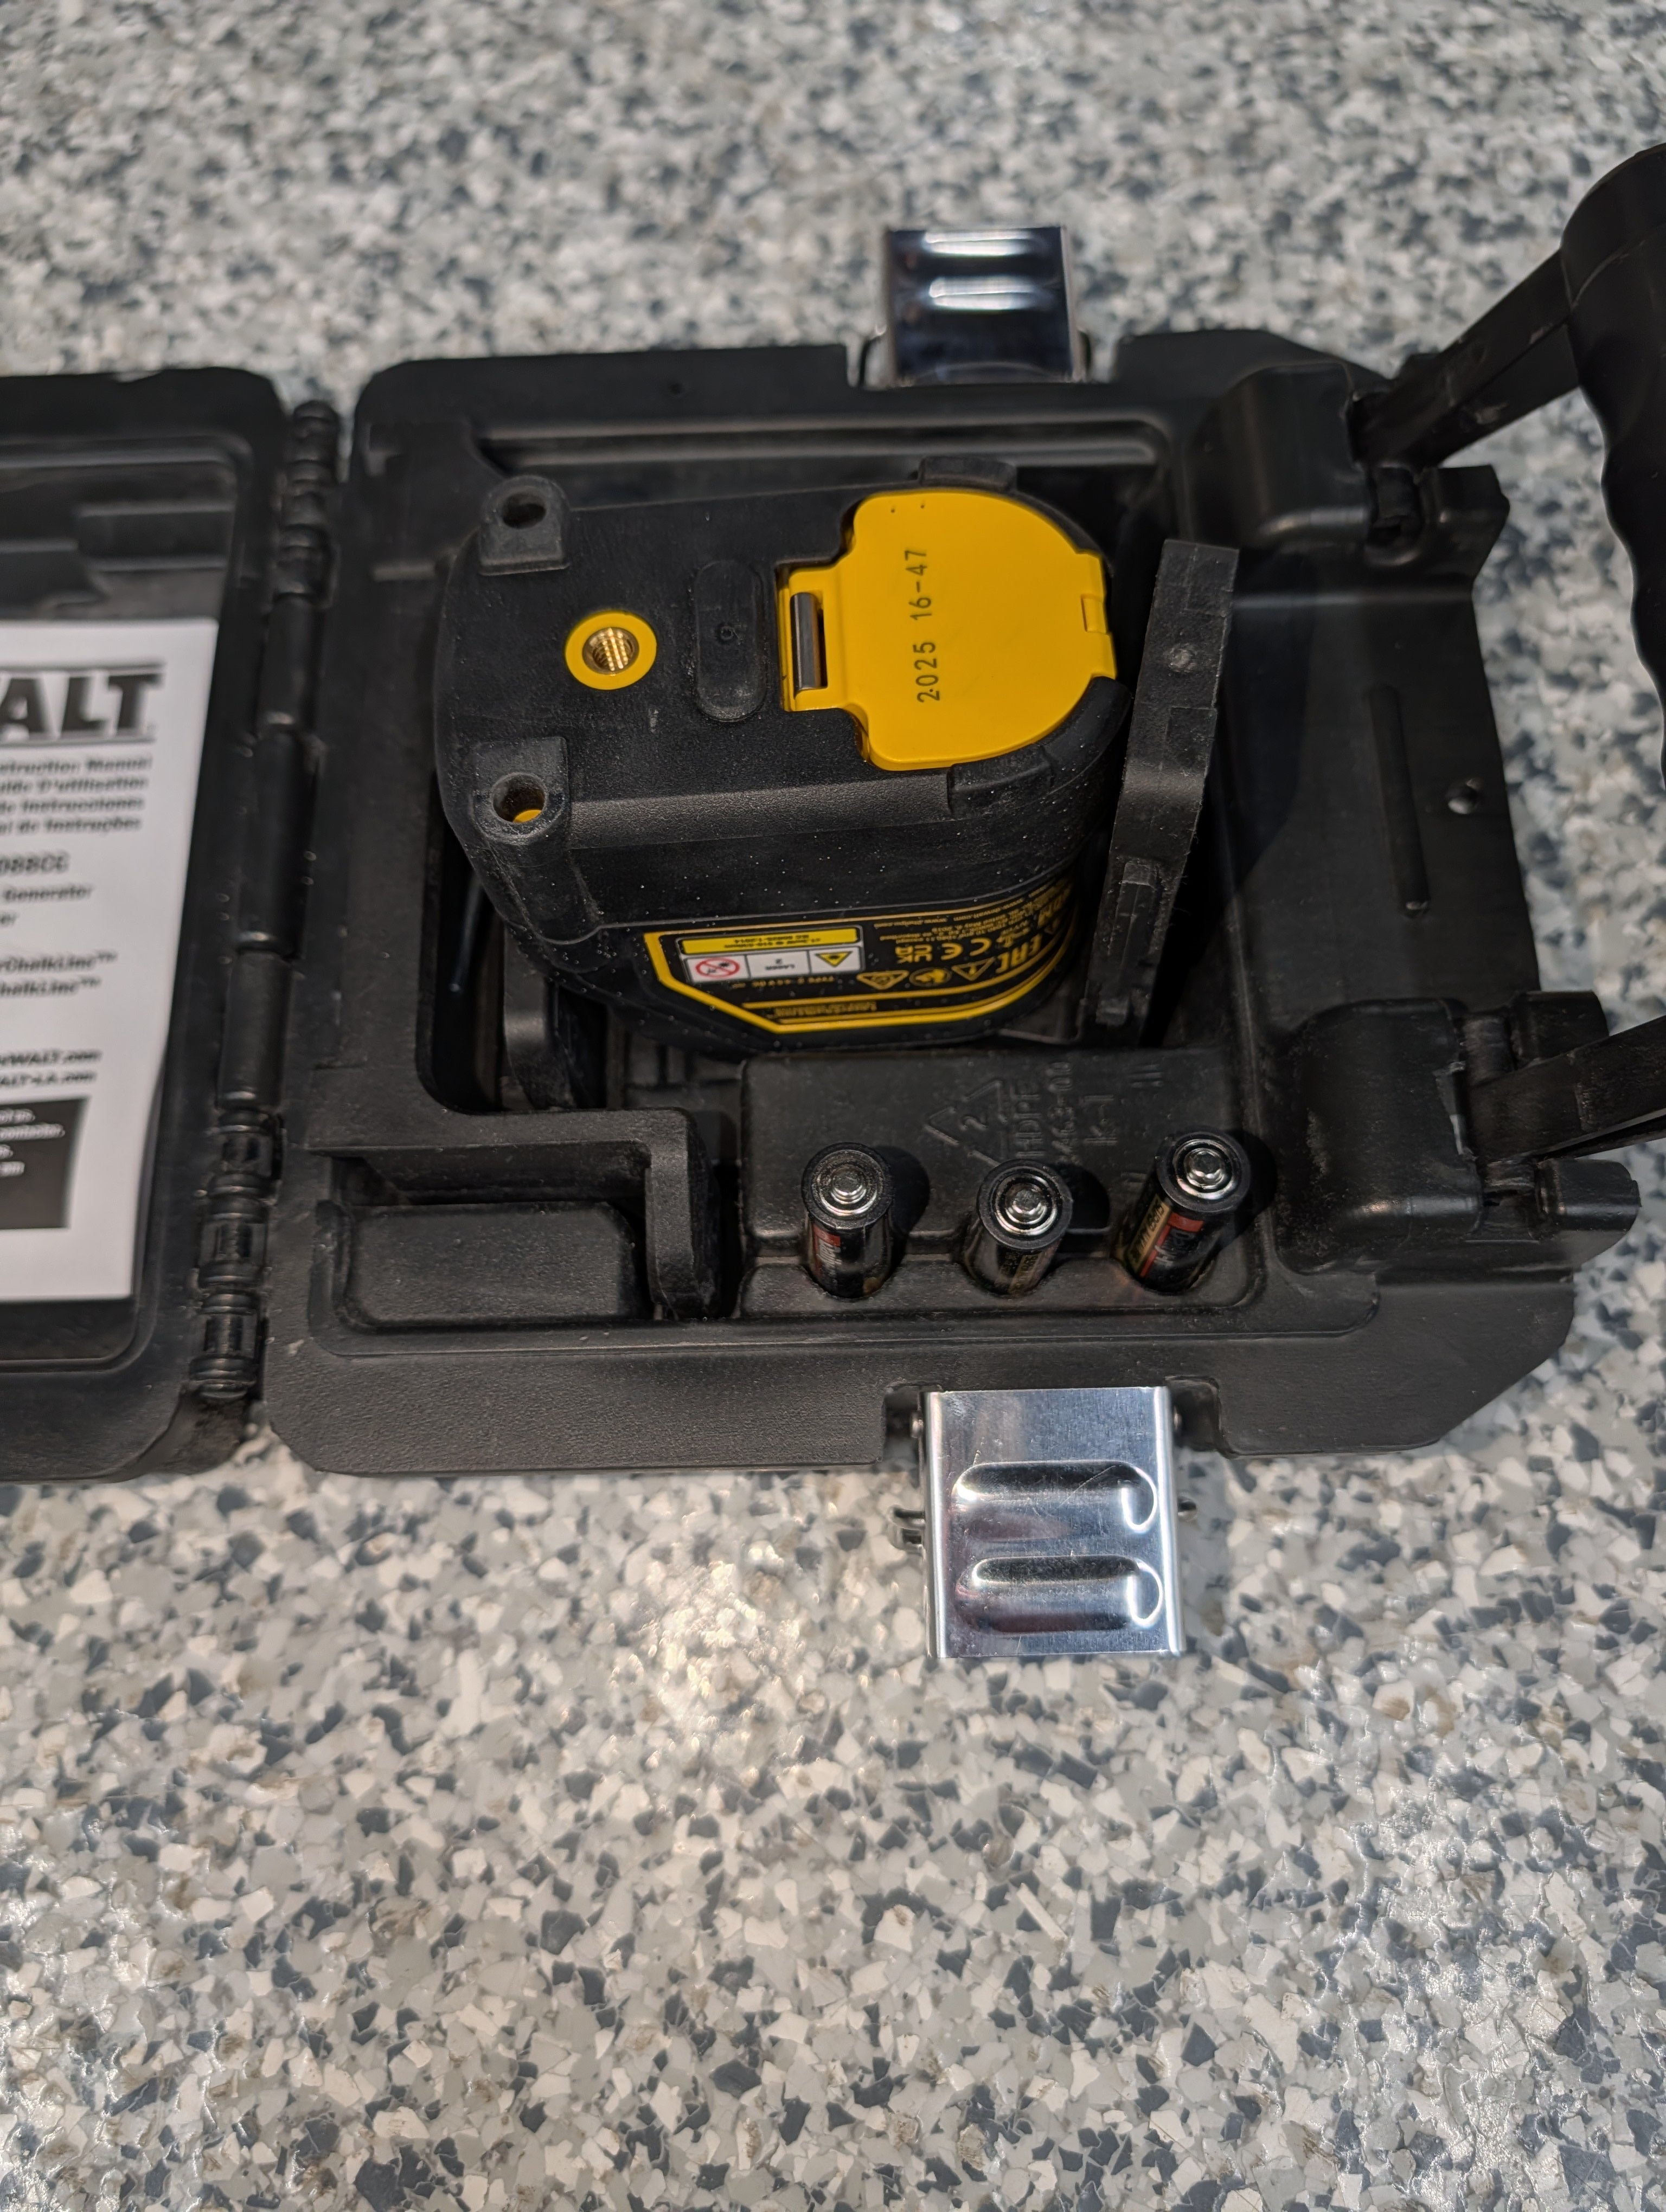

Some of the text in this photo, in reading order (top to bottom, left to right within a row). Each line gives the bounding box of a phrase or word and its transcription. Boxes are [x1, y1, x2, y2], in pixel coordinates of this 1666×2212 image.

[905, 548, 940, 703] 2025 16-47
[85, 756, 153, 771] Manual
